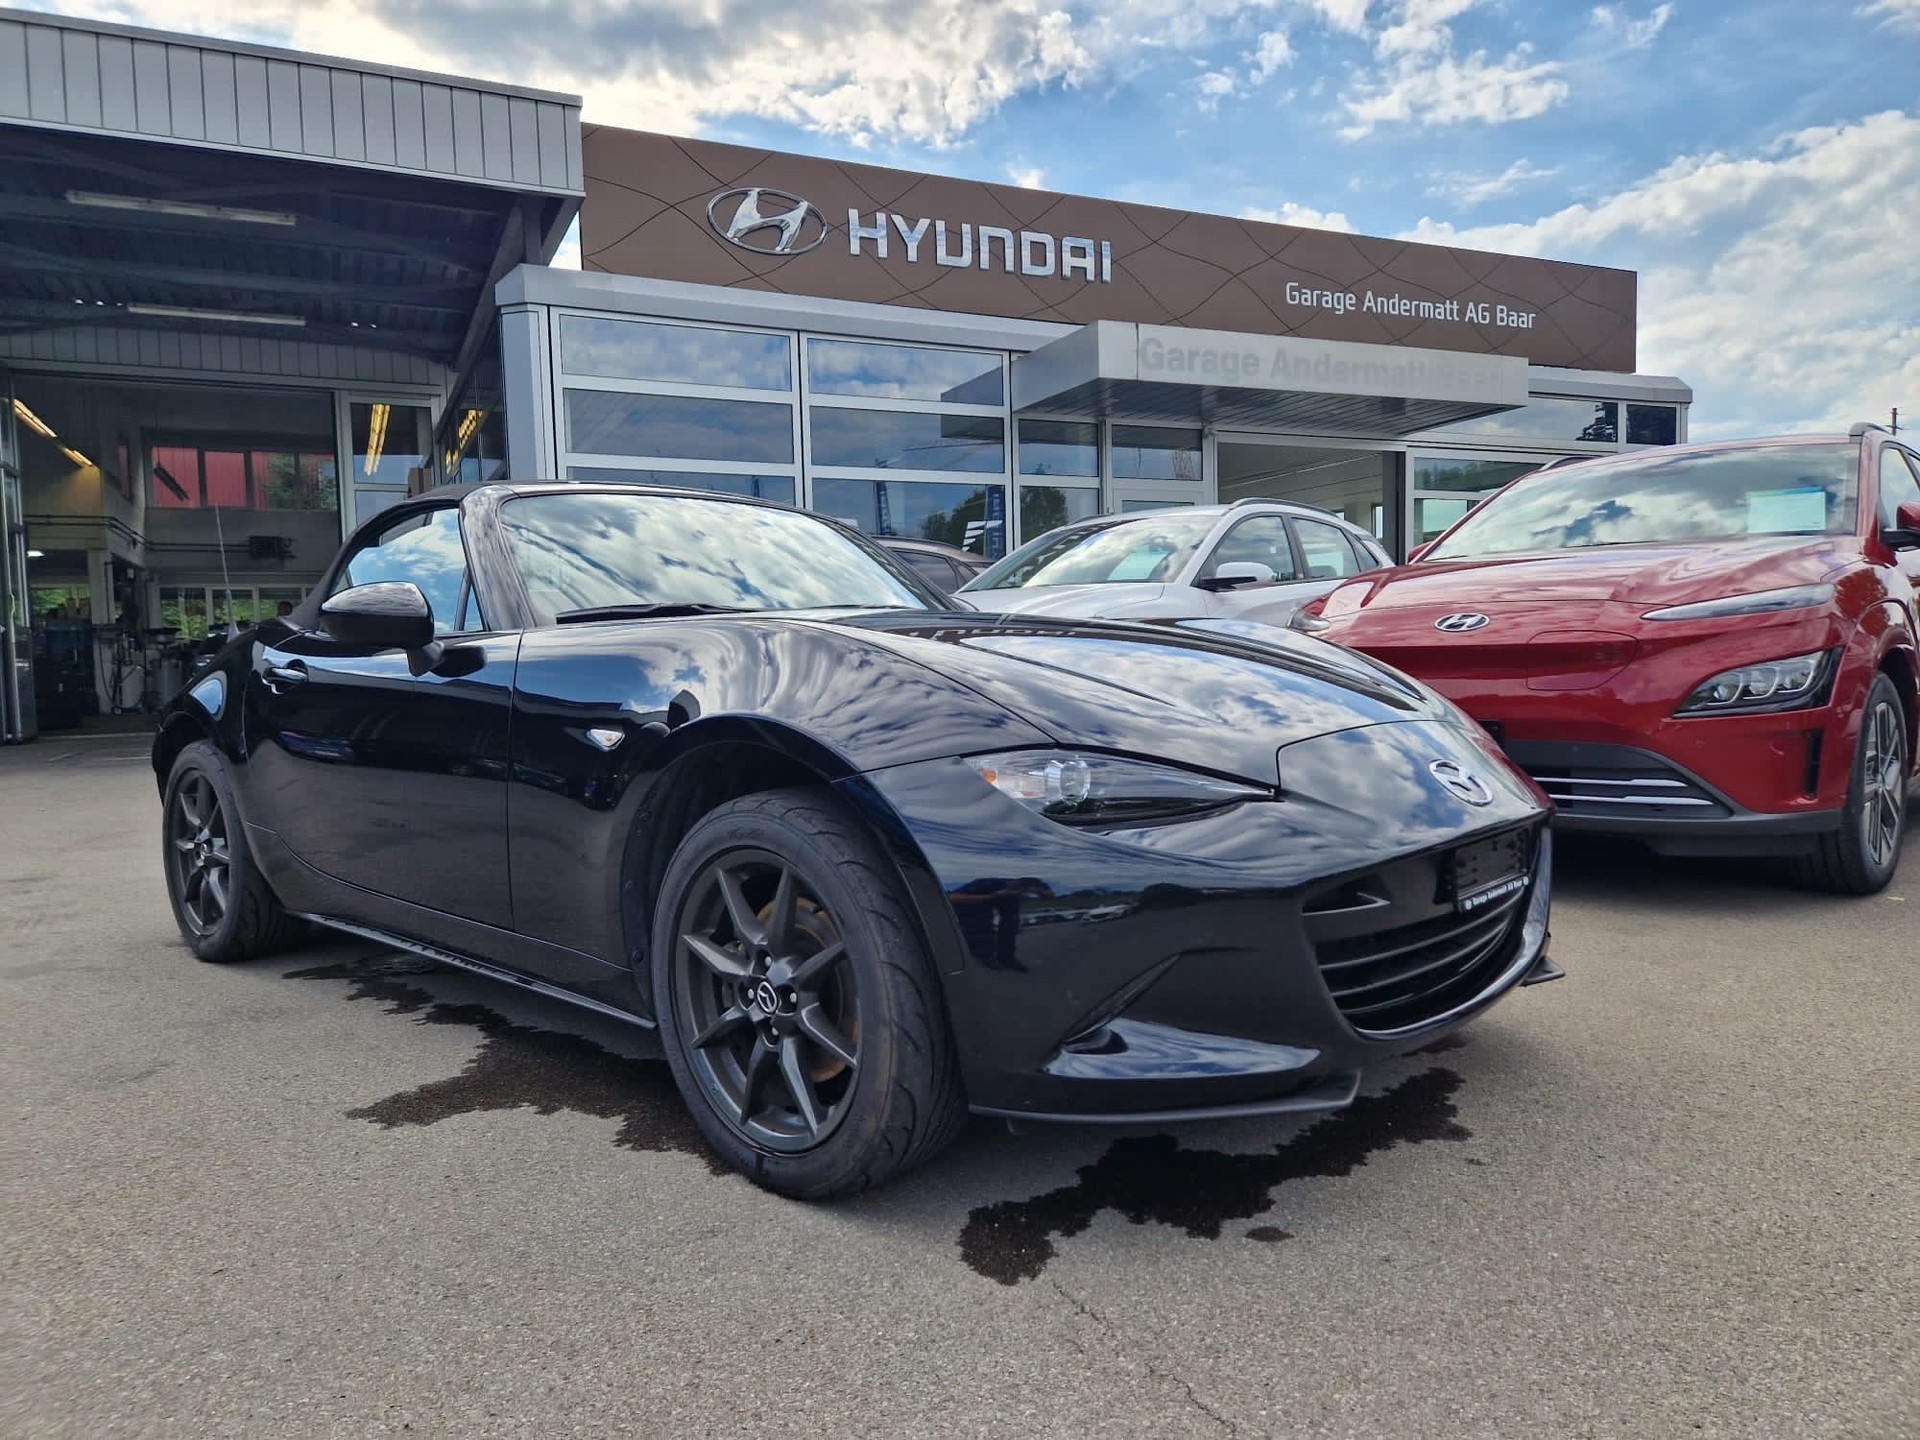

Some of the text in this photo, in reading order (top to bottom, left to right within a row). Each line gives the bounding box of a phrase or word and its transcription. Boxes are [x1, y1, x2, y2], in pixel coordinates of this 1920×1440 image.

[848, 208, 1112, 284] HYUNDAI
[1286, 282, 1537, 329] Garage Andermatt AG Baar
[1140, 337, 1260, 383] Garage
